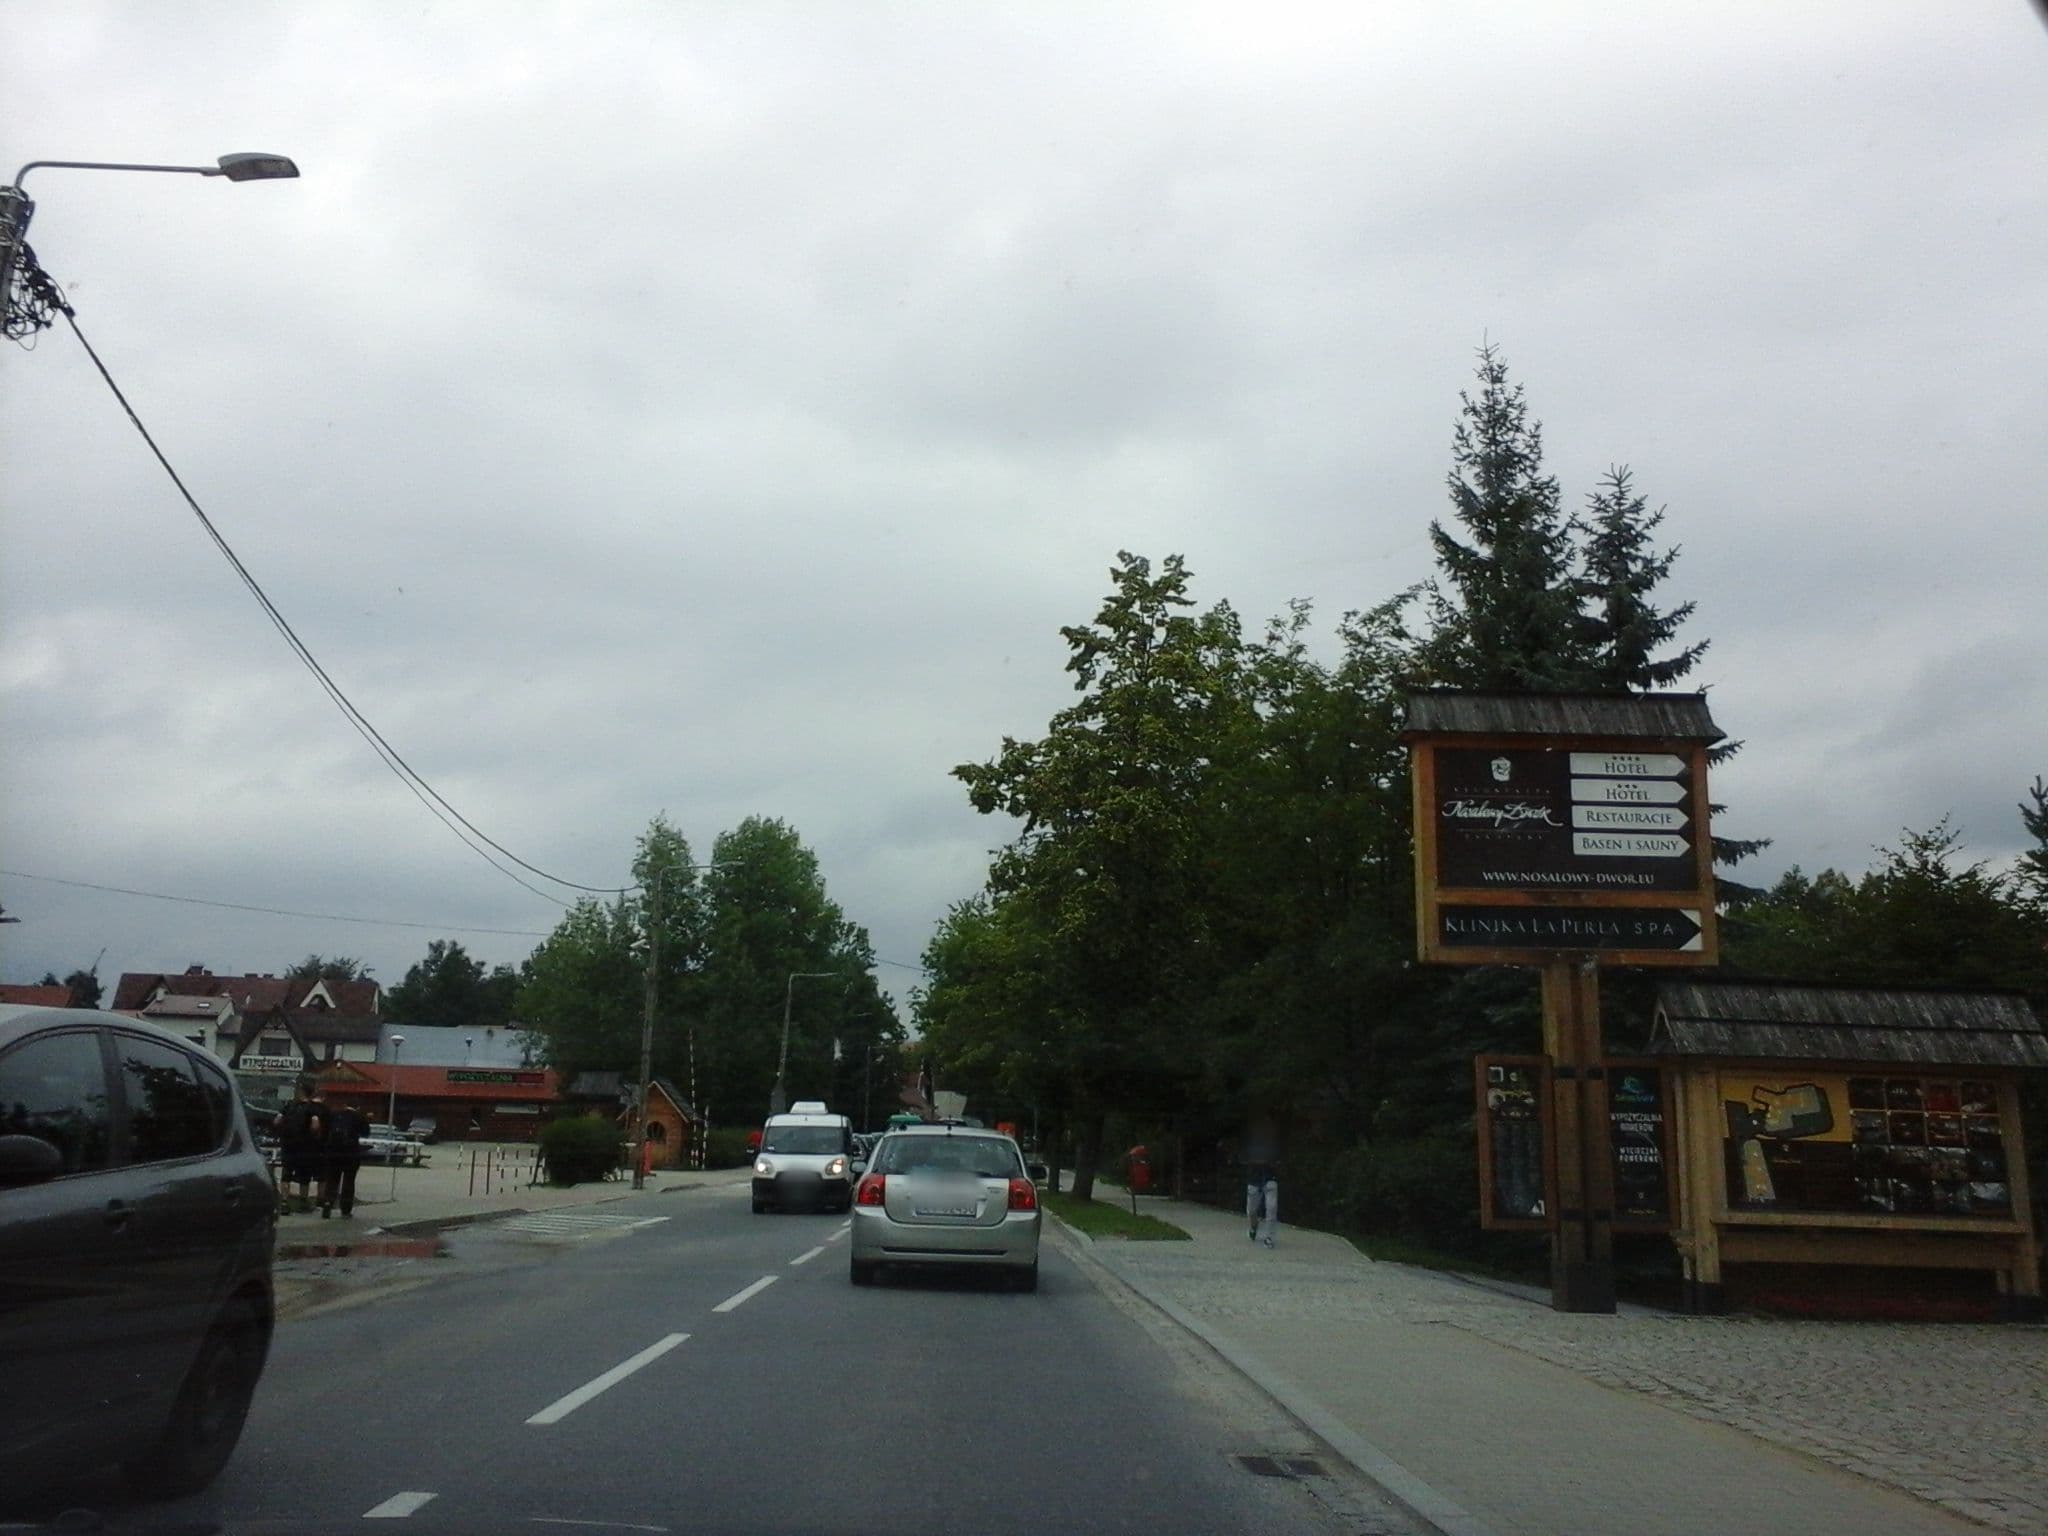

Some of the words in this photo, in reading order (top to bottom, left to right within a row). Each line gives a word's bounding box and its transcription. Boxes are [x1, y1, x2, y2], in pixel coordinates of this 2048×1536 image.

[1586, 810, 1673, 824] RESTAURACJE
[1582, 837, 1622, 849] BASEN
[1637, 839, 1679, 851] SAUNY
[1445, 916, 1527, 934] KLINIKA
